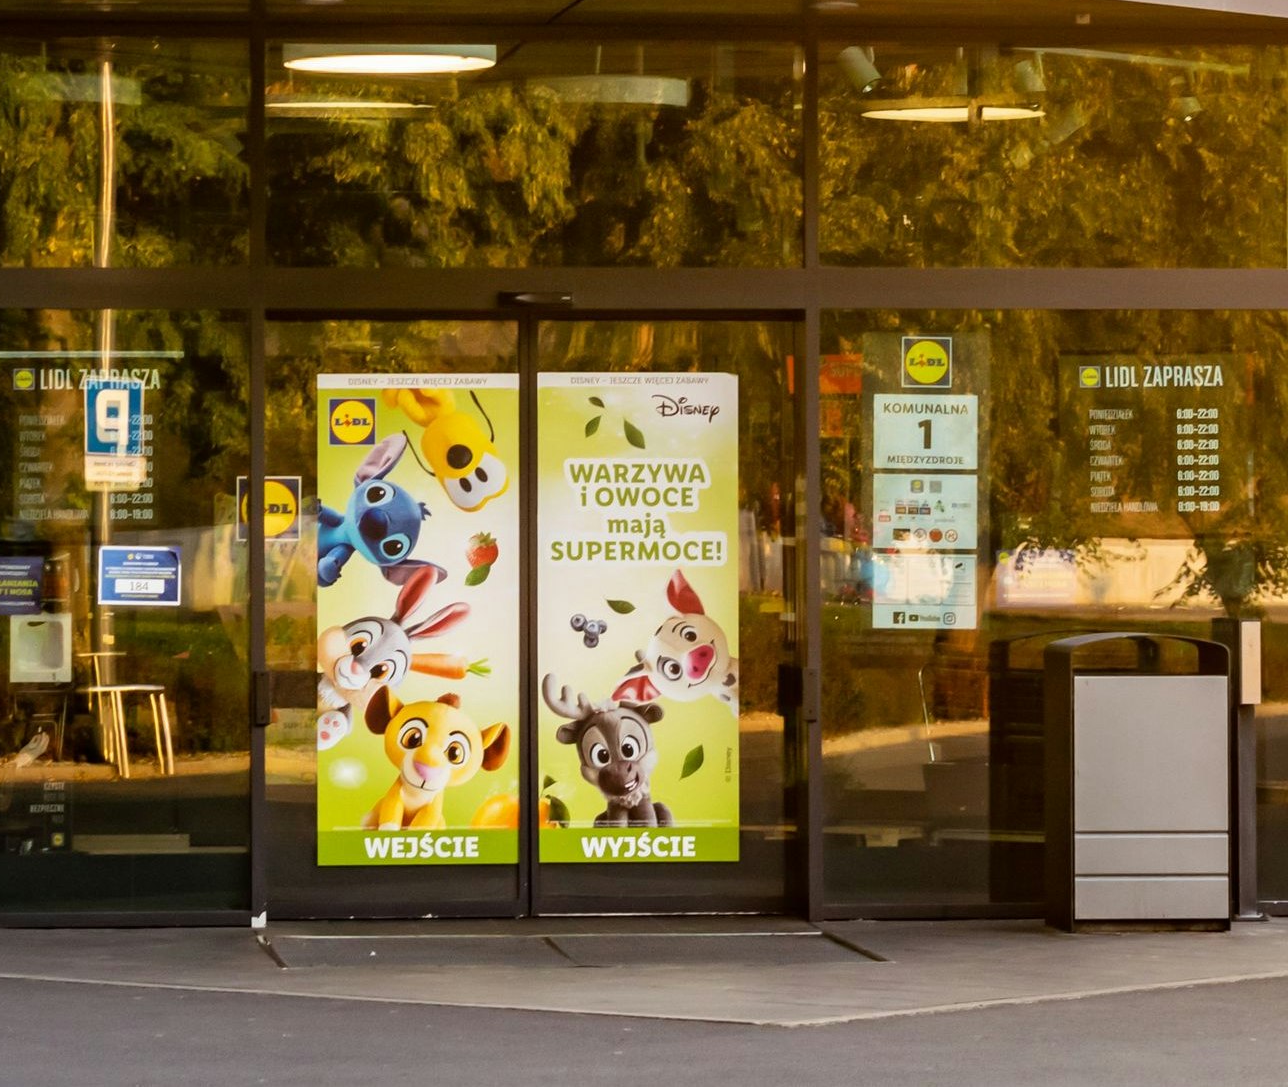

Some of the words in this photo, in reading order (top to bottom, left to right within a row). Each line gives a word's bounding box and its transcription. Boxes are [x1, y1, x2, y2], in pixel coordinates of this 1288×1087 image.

[40, 368, 74, 390] LIDL
[78, 368, 161, 390] ZAPRASZA
[348, 378, 378, 386] DISNEY
[387, 378, 419, 386] JESZCZE
[422, 378, 452, 387] WIĘCEJ
[454, 377, 487, 385] ZABAWY
[570, 377, 600, 385] DISNEY
[609, 377, 641, 385] JESZCZE
[644, 377, 674, 386] WIĘCEJ
[675, 376, 709, 384] ZABAWY
[1105, 366, 1139, 387] LIDL
[1143, 365, 1224, 387] ZAPRASZA
[883, 403, 969, 415] KOMUNALNA
[918, 419, 932, 449] 1
[887, 455, 965, 465] MIĘDZYZDROJE
[569, 463, 705, 483] WARZYWA
[581, 486, 587, 507] i
[595, 487, 694, 507] OWOCE
[608, 513, 666, 539] mają
[551, 541, 722, 561] SUPERMOCE!
[364, 832, 479, 859] WEJŚCIE
[581, 832, 696, 858] WYJŚCIE
